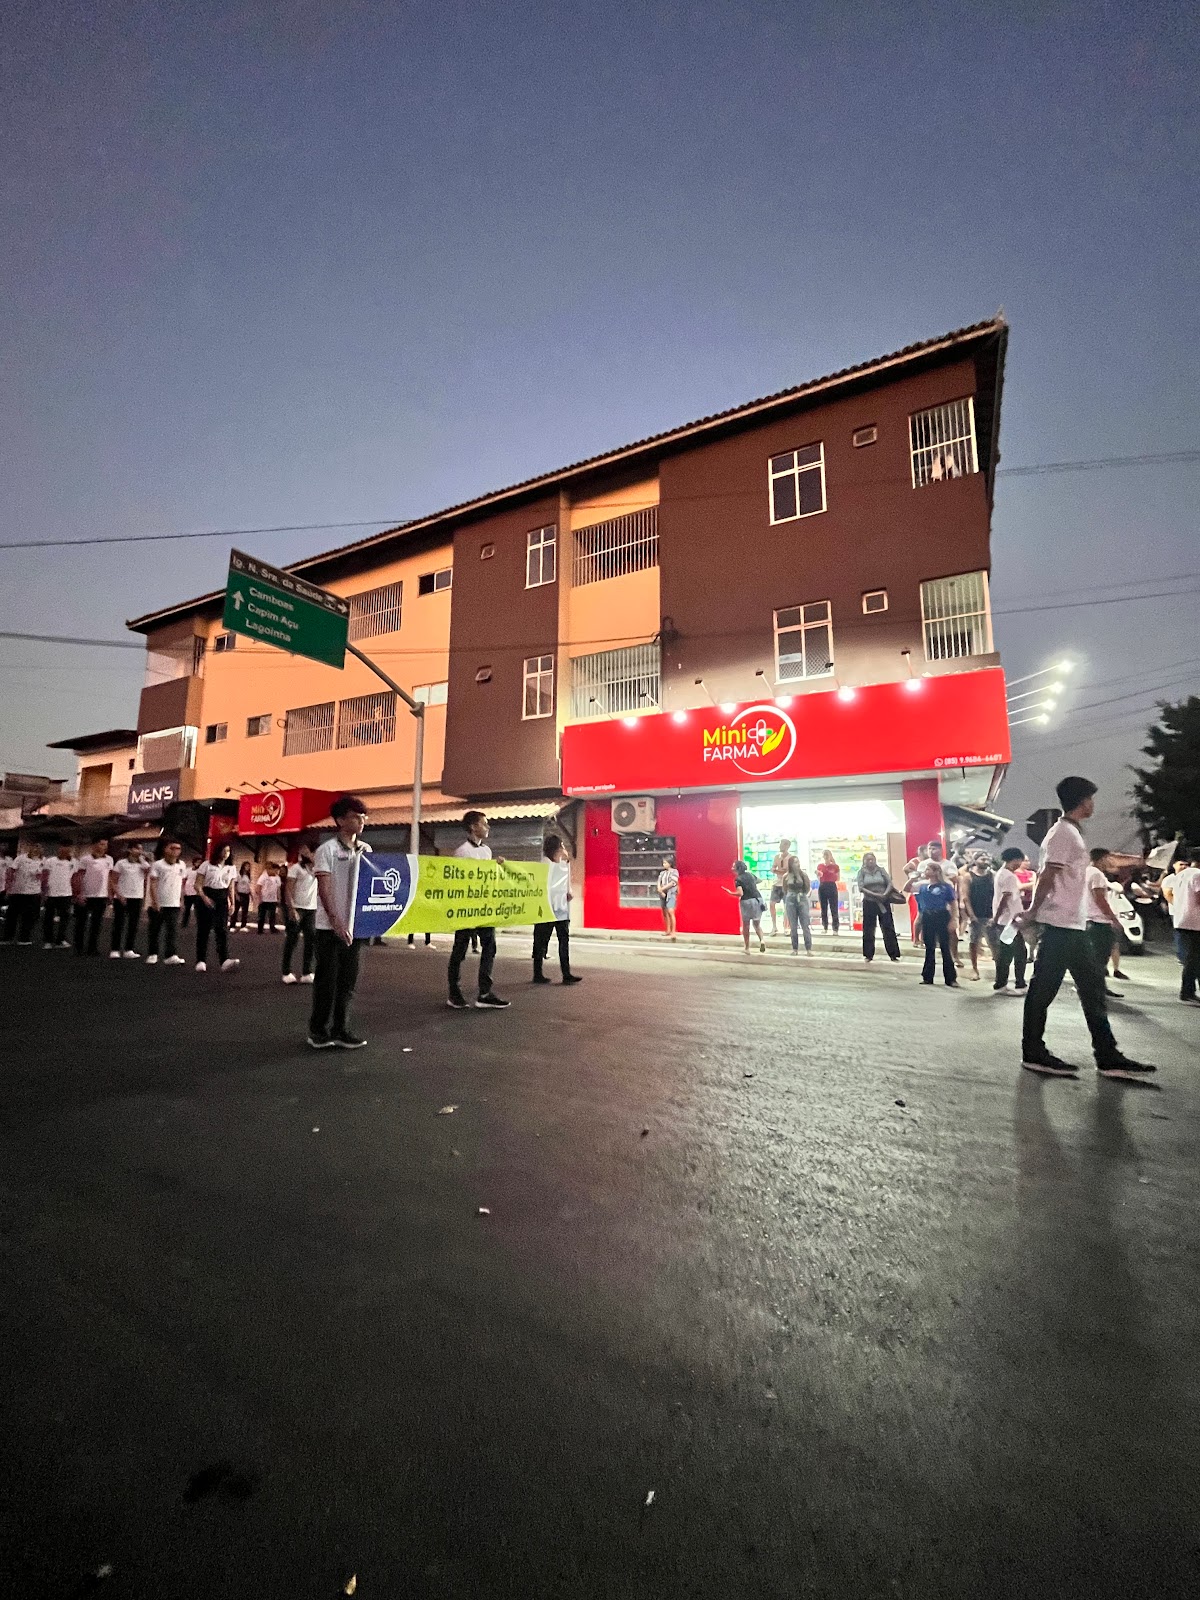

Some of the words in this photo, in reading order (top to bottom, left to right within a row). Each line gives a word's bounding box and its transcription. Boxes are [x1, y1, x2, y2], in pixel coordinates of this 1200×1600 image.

[248, 563, 259, 574] N.
[261, 568, 279, 583] Sra.
[282, 577, 294, 589] da
[295, 583, 323, 602] Saúde
[249, 586, 294, 611] Camboas
[247, 603, 279, 622] Capim
[280, 615, 299, 630] Açu
[245, 618, 291, 643] Lagoinha
[703, 723, 747, 747] Mini
[703, 743, 760, 762] FARMA
[131, 785, 174, 804] MEN'S
[443, 865, 465, 880] Bits
[467, 870, 474, 879] e
[424, 888, 444, 899] em
[447, 888, 464, 899] um
[467, 885, 489, 899] balé
[492, 886, 543, 898] construindo
[361, 903, 403, 912] INFORMÁTICA
[446, 908, 454, 918] o
[457, 904, 493, 918] mundo
[495, 903, 526, 919] digital.
